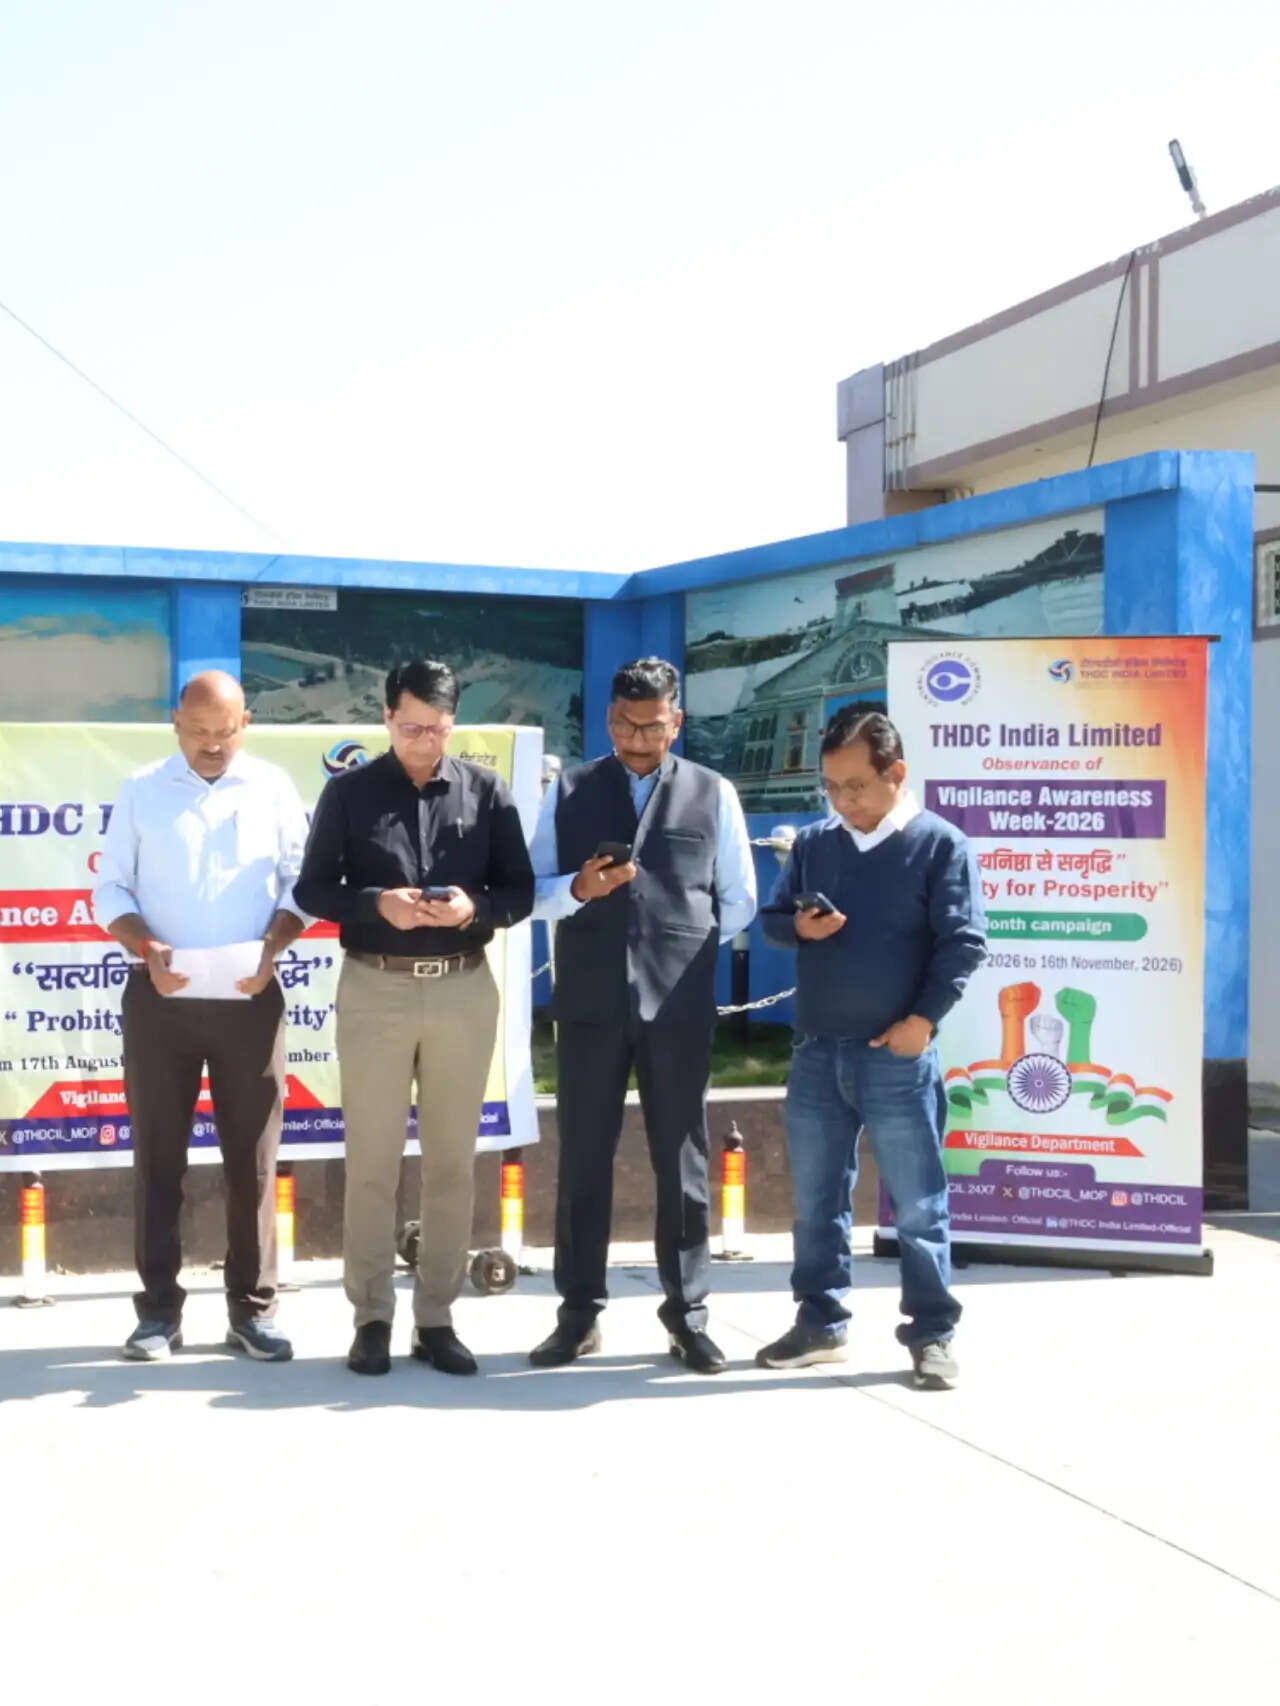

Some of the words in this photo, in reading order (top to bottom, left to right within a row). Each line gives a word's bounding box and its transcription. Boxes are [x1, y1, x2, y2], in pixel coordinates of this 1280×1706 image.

[930, 723, 991, 748] THDC
[1000, 723, 1060, 748] India
[1069, 723, 1162, 748] Limited
[982, 756, 1080, 771] Observance
[1085, 756, 1104, 771] of
[937, 786, 1032, 808] Vigilance
[1038, 786, 1153, 807] Awareness
[988, 811, 1106, 833] Week-2026
[1006, 879, 1036, 896] for
[1030, 918, 1112, 935] campaign
[987, 954, 1020, 969] 2026
[1023, 955, 1037, 968] to
[1041, 956, 1068, 969] 16th
[1142, 957, 1183, 973] 2026)
[27, 1009, 124, 1036] Probity
[20, 1055, 59, 1071] 17th
[287, 1049, 331, 1063] mber
[60, 1090, 127, 1108] Vigilanc
[314, 1117, 345, 1129] Officia
[965, 1132, 1028, 1149] Vigilance
[1032, 1136, 1115, 1152] Department
[1006, 1165, 1043, 1177] Follow
[968, 1184, 995, 1195] 24X7
[1131, 1191, 1188, 1206] @THDCIL
